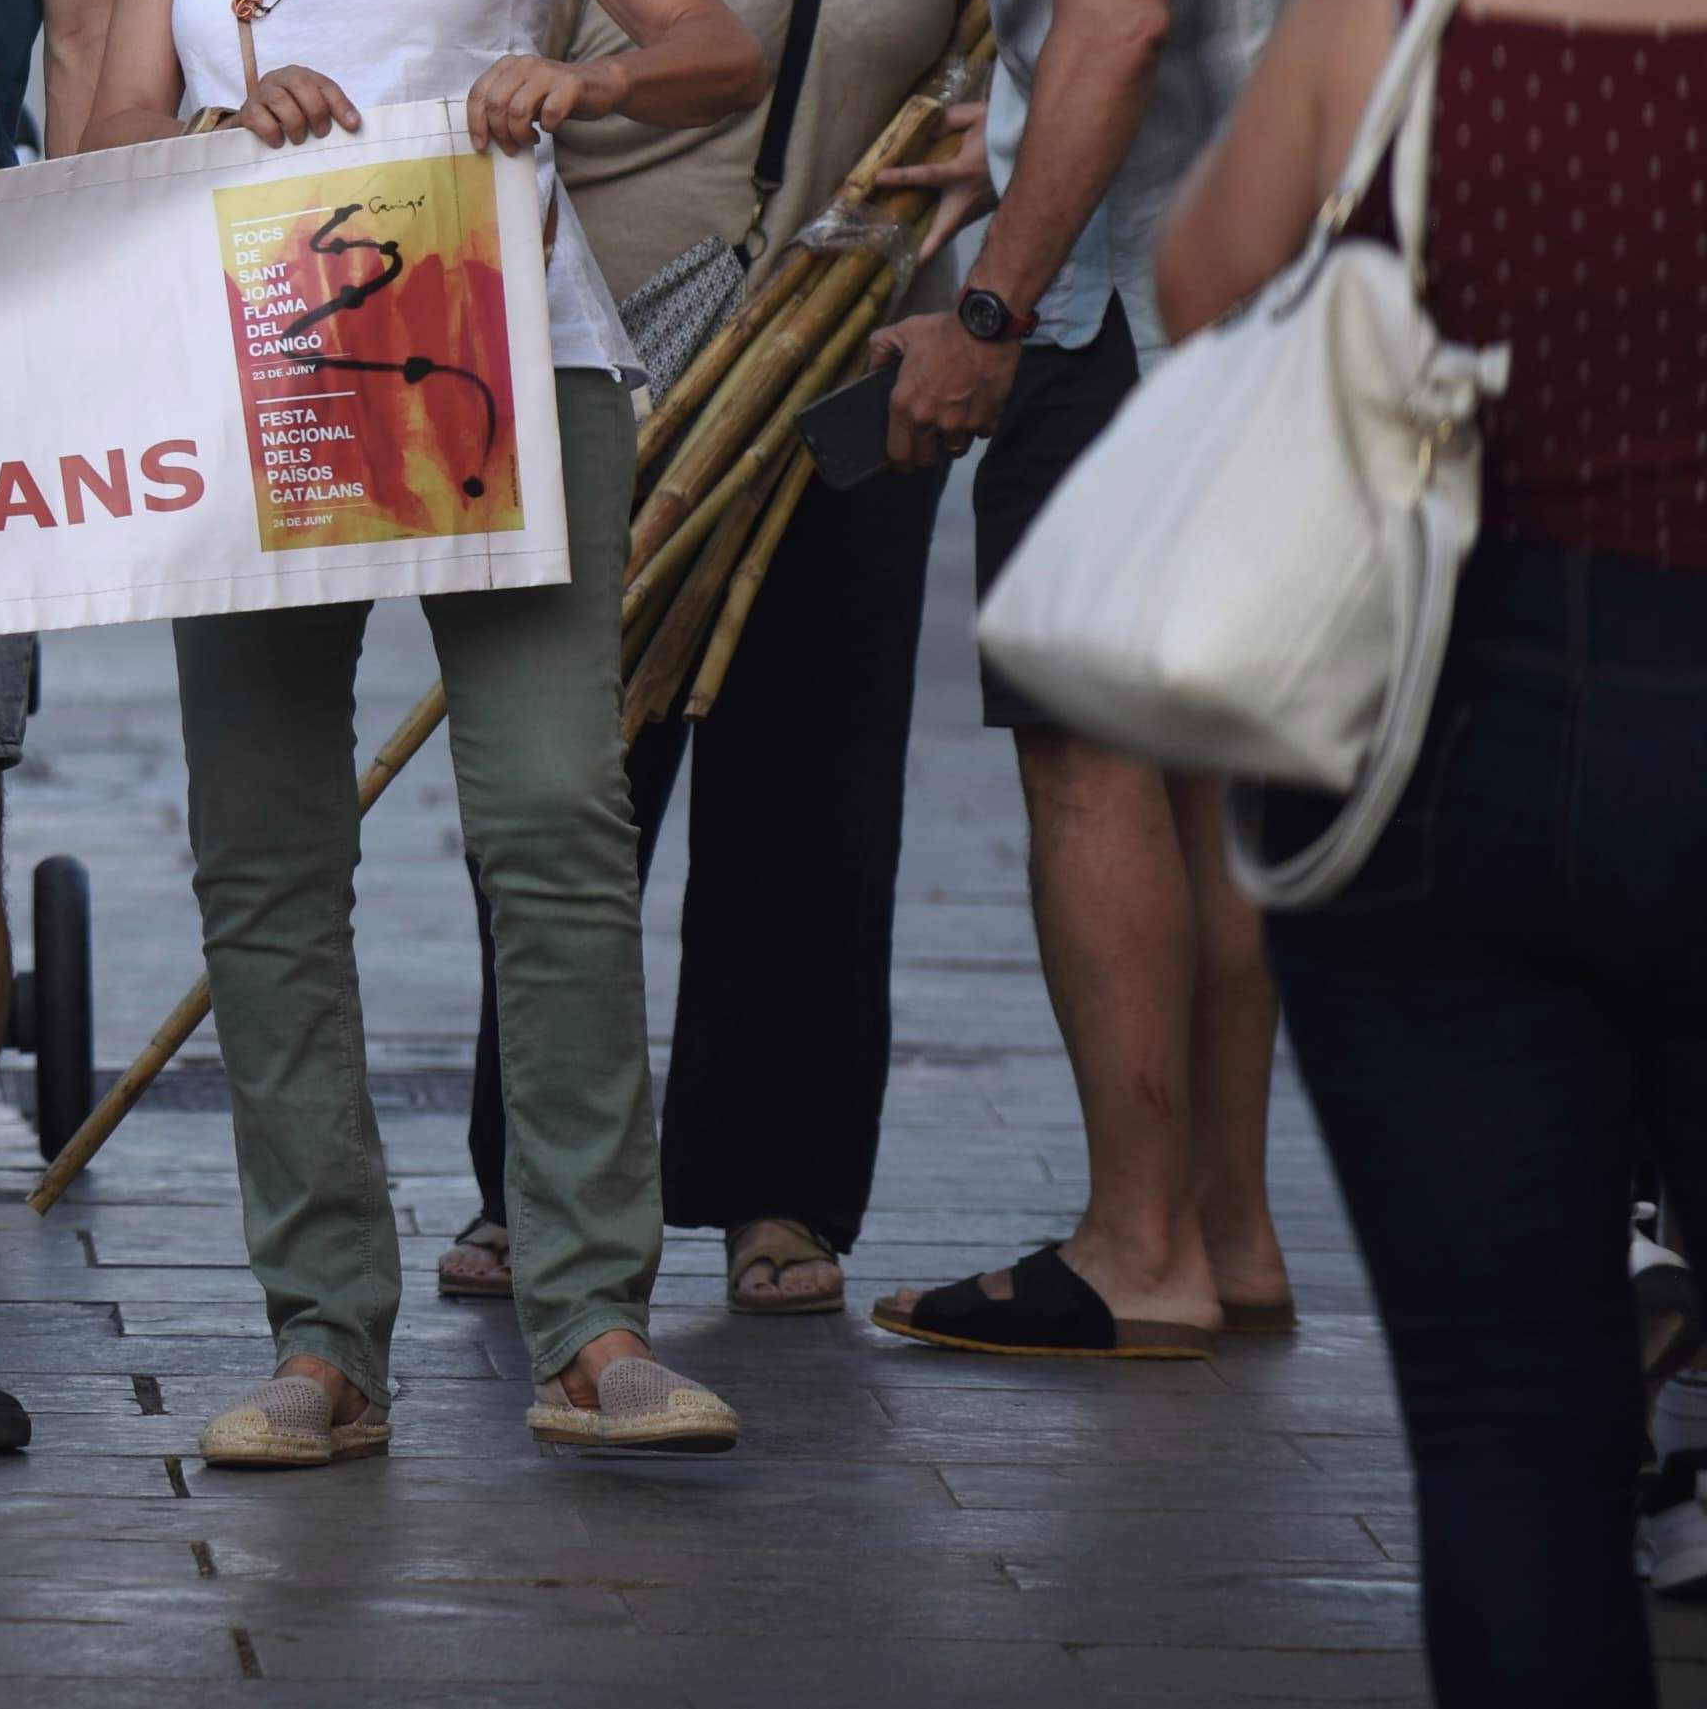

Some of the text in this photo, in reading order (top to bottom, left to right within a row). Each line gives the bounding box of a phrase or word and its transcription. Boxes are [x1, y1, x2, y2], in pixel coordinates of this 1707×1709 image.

[234, 227, 284, 247] FOCS
[236, 249, 261, 265] DE
[239, 262, 287, 283] SANT
[241, 281, 291, 302] JOAN
[243, 298, 308, 320] FLAMA
[246, 321, 283, 338] DEL
[249, 331, 322, 357] CANIGÓ
[252, 365, 316, 380] 23 DE JUNY
[259, 408, 317, 427] FESTA
[261, 425, 355, 446] NACIONAL
[264, 448, 311, 465] DELS
[267, 465, 333, 484] PAÏSOS
[270, 482, 364, 503] CATALANS
[273, 515, 333, 528] 24 DE JUNY
